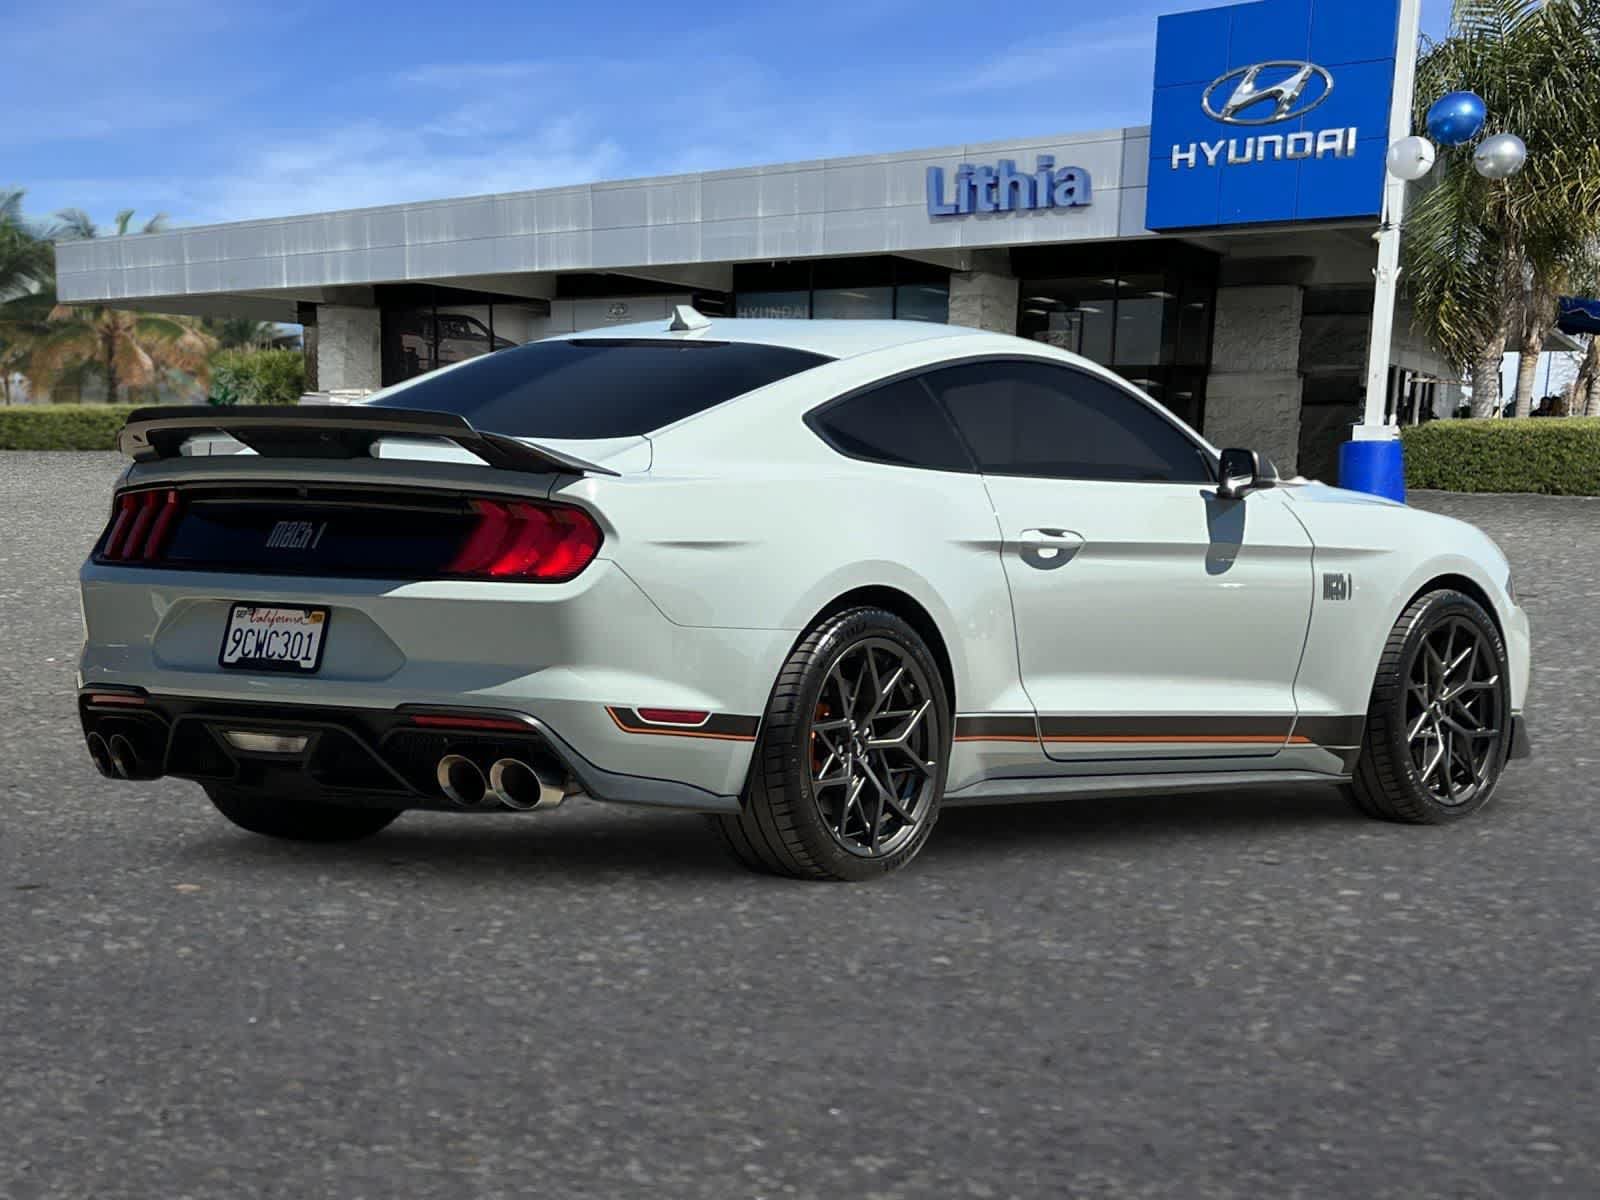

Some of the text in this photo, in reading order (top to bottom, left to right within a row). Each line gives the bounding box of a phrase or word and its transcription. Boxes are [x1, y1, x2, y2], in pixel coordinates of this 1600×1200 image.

[1171, 127, 1357, 170] HYUNDAI
[927, 155, 1091, 217] Lithia
[249, 608, 309, 628] California
[228, 628, 313, 661] 9CWC301
